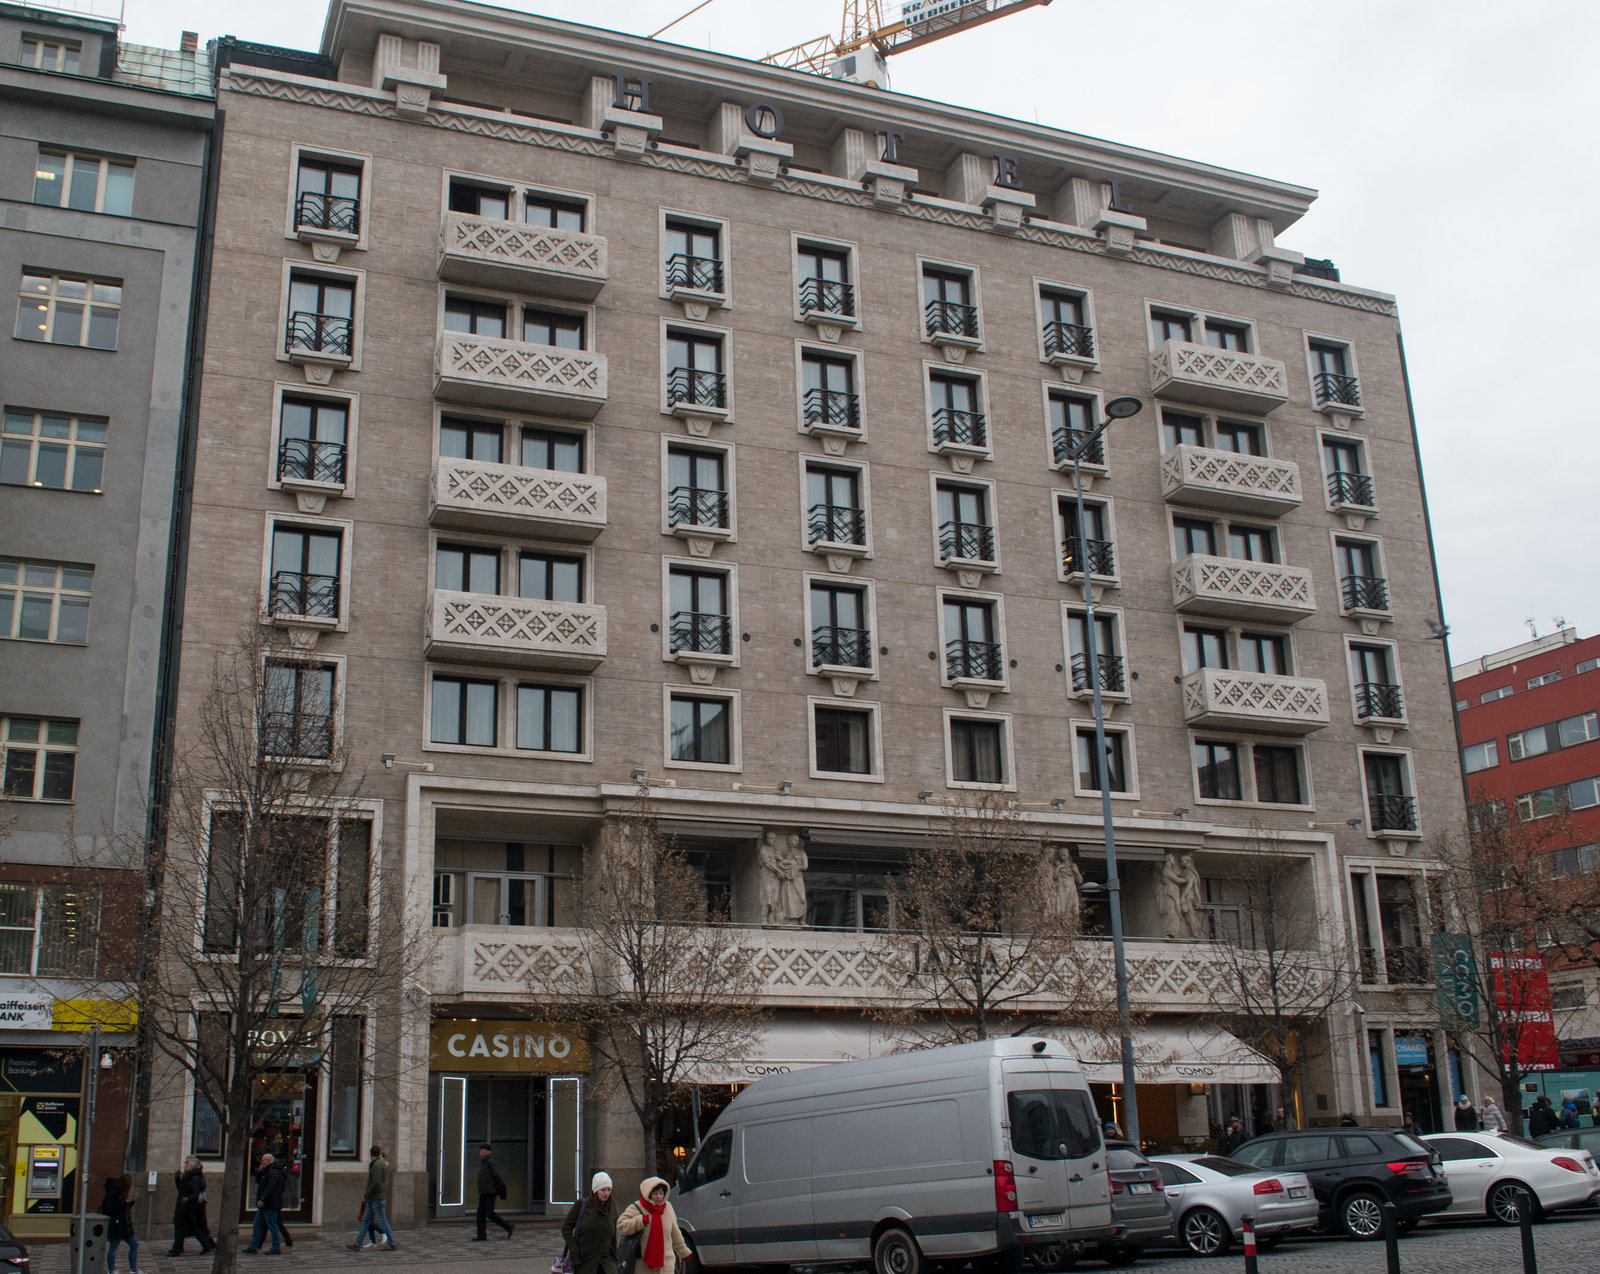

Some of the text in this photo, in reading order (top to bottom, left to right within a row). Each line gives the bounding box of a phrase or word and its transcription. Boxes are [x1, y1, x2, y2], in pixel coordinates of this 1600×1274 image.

[906, 0, 978, 25] LIEBHER
[612, 73, 1134, 214] HOTEL
[247, 1029, 318, 1048] ROYL
[447, 1033, 571, 1059] CASINO
[744, 1064, 791, 1075] COMO
[1175, 1066, 1214, 1076] COMO
